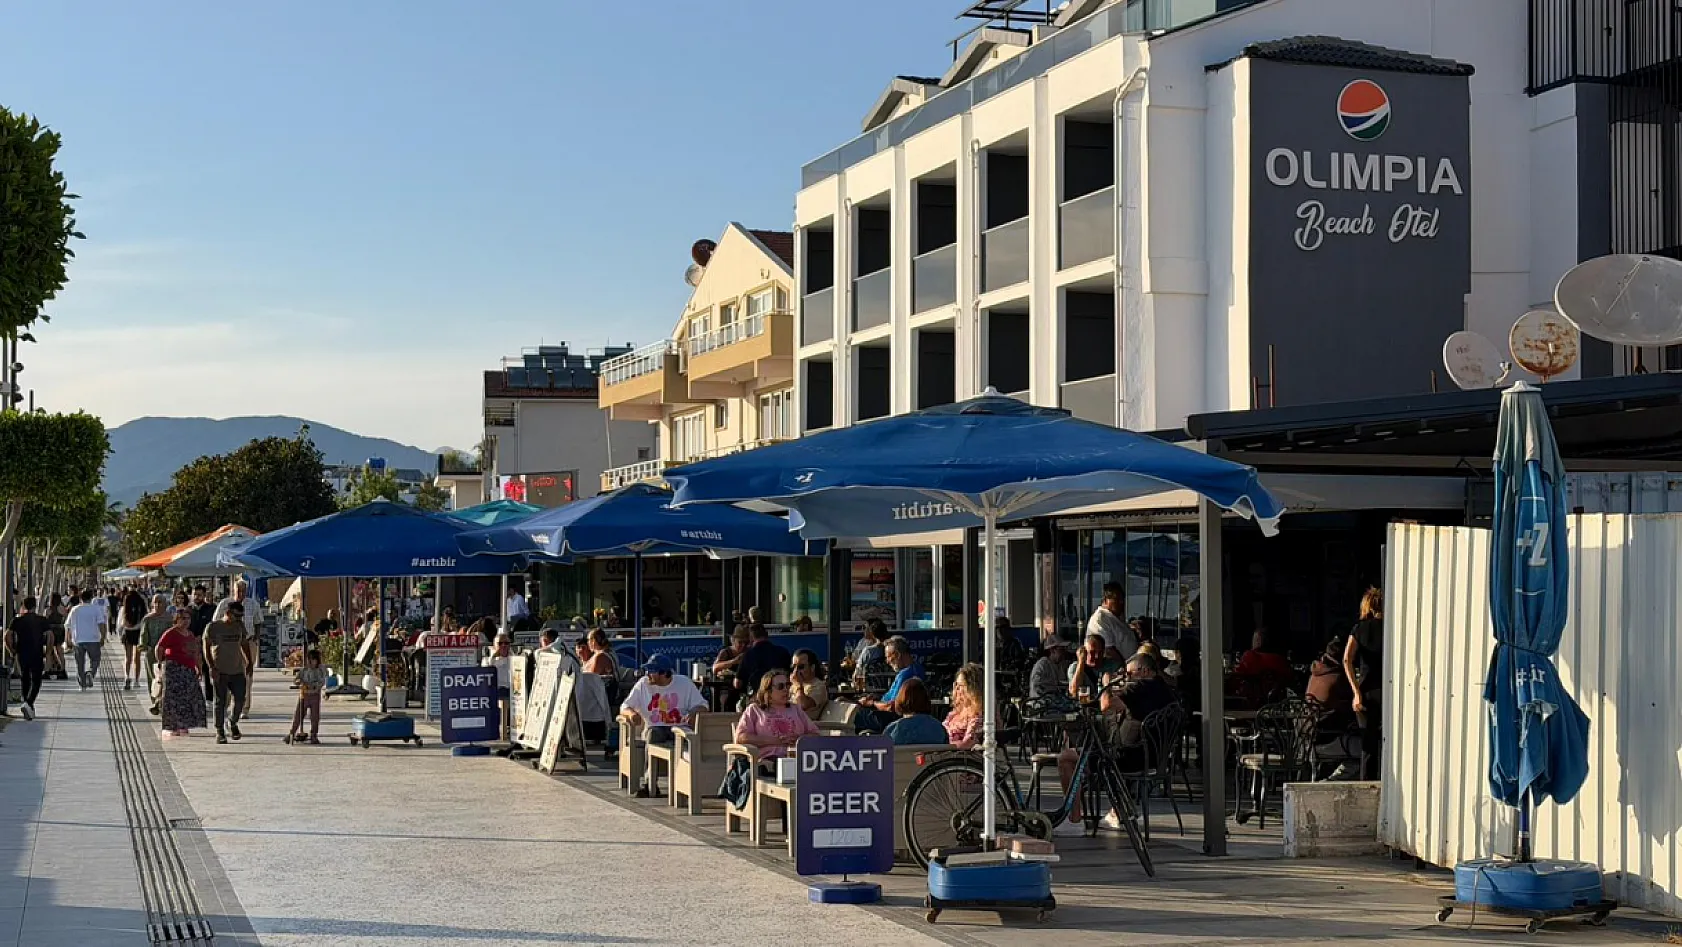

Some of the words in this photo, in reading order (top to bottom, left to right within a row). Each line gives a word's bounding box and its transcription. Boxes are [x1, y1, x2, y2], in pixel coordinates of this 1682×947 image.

[1265, 147, 1463, 195] OLIMPIA
[1294, 200, 1375, 251] Beach
[1388, 203, 1440, 243] Otel
[426, 636, 449, 647] RENT
[451, 635, 457, 646] A
[459, 634, 477, 646] CAR
[443, 673, 494, 688] DRAFT
[448, 696, 490, 711] BEER
[801, 749, 888, 773] DRAFT
[808, 791, 881, 815] BEER
